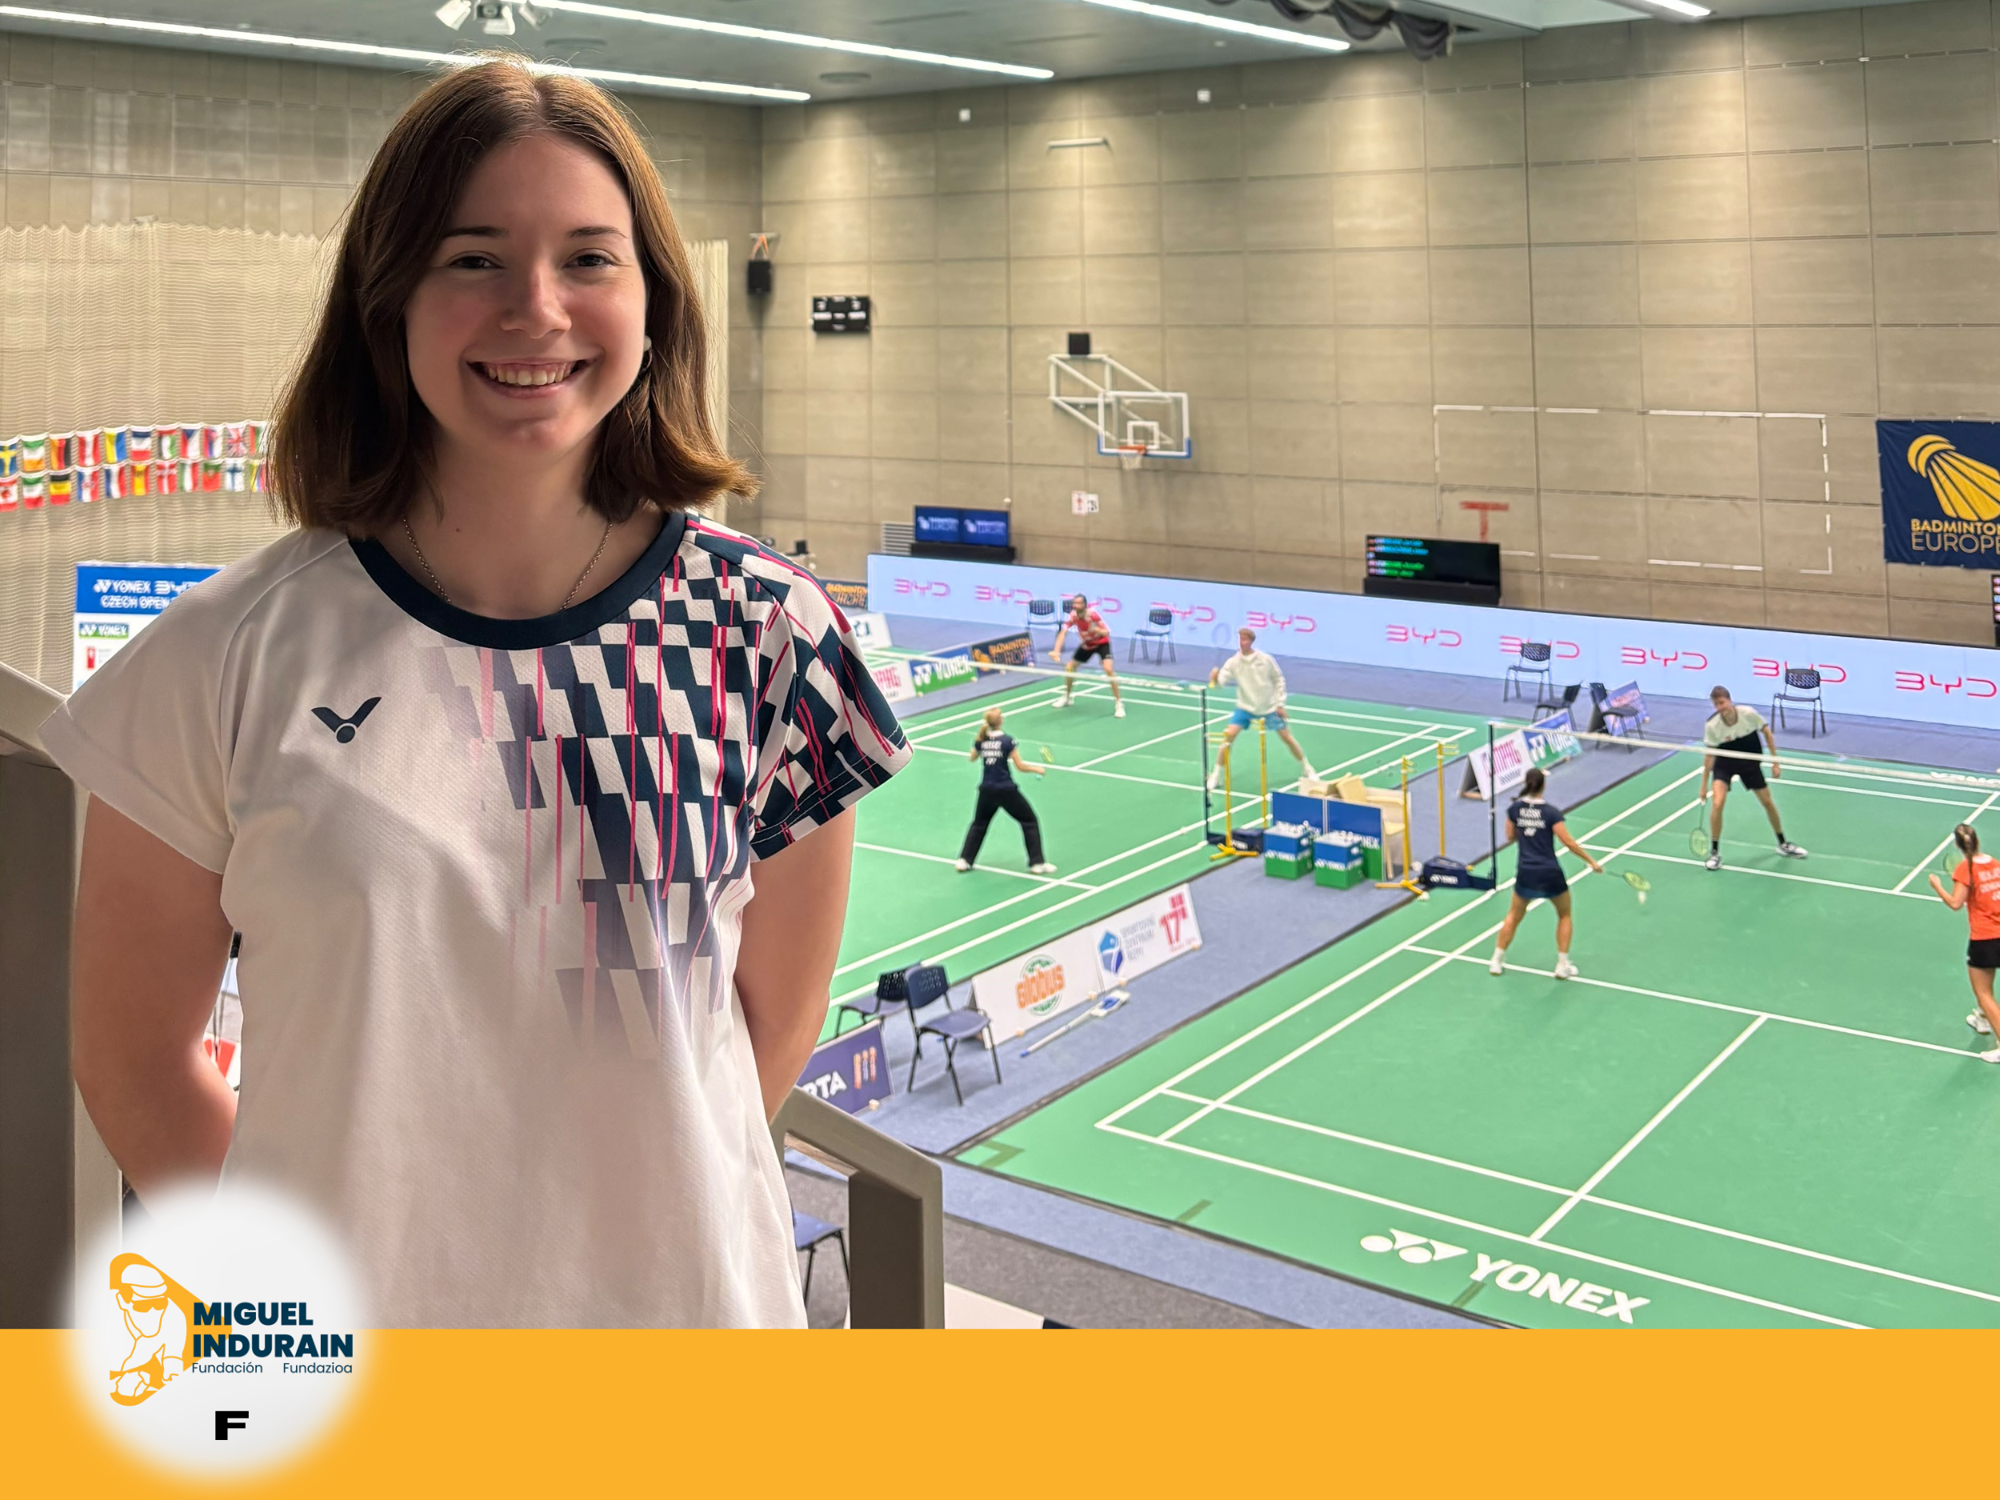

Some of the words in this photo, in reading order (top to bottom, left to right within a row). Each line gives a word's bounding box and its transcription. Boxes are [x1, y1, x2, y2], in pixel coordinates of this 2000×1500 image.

[1910, 518, 2000, 536] BADMINTO
[112, 580, 151, 594] YONEX
[895, 578, 950, 598] BYD
[101, 595, 138, 609] CZECH
[139, 596, 171, 610] OPEN
[1247, 611, 1317, 633] BYD
[1386, 624, 1463, 648] BYD
[1499, 635, 1581, 659] BD
[1621, 646, 1708, 671] BYD
[1753, 658, 1847, 684] BD
[1895, 671, 1998, 698] BYD
[1470, 1253, 1651, 1324] YONEX
